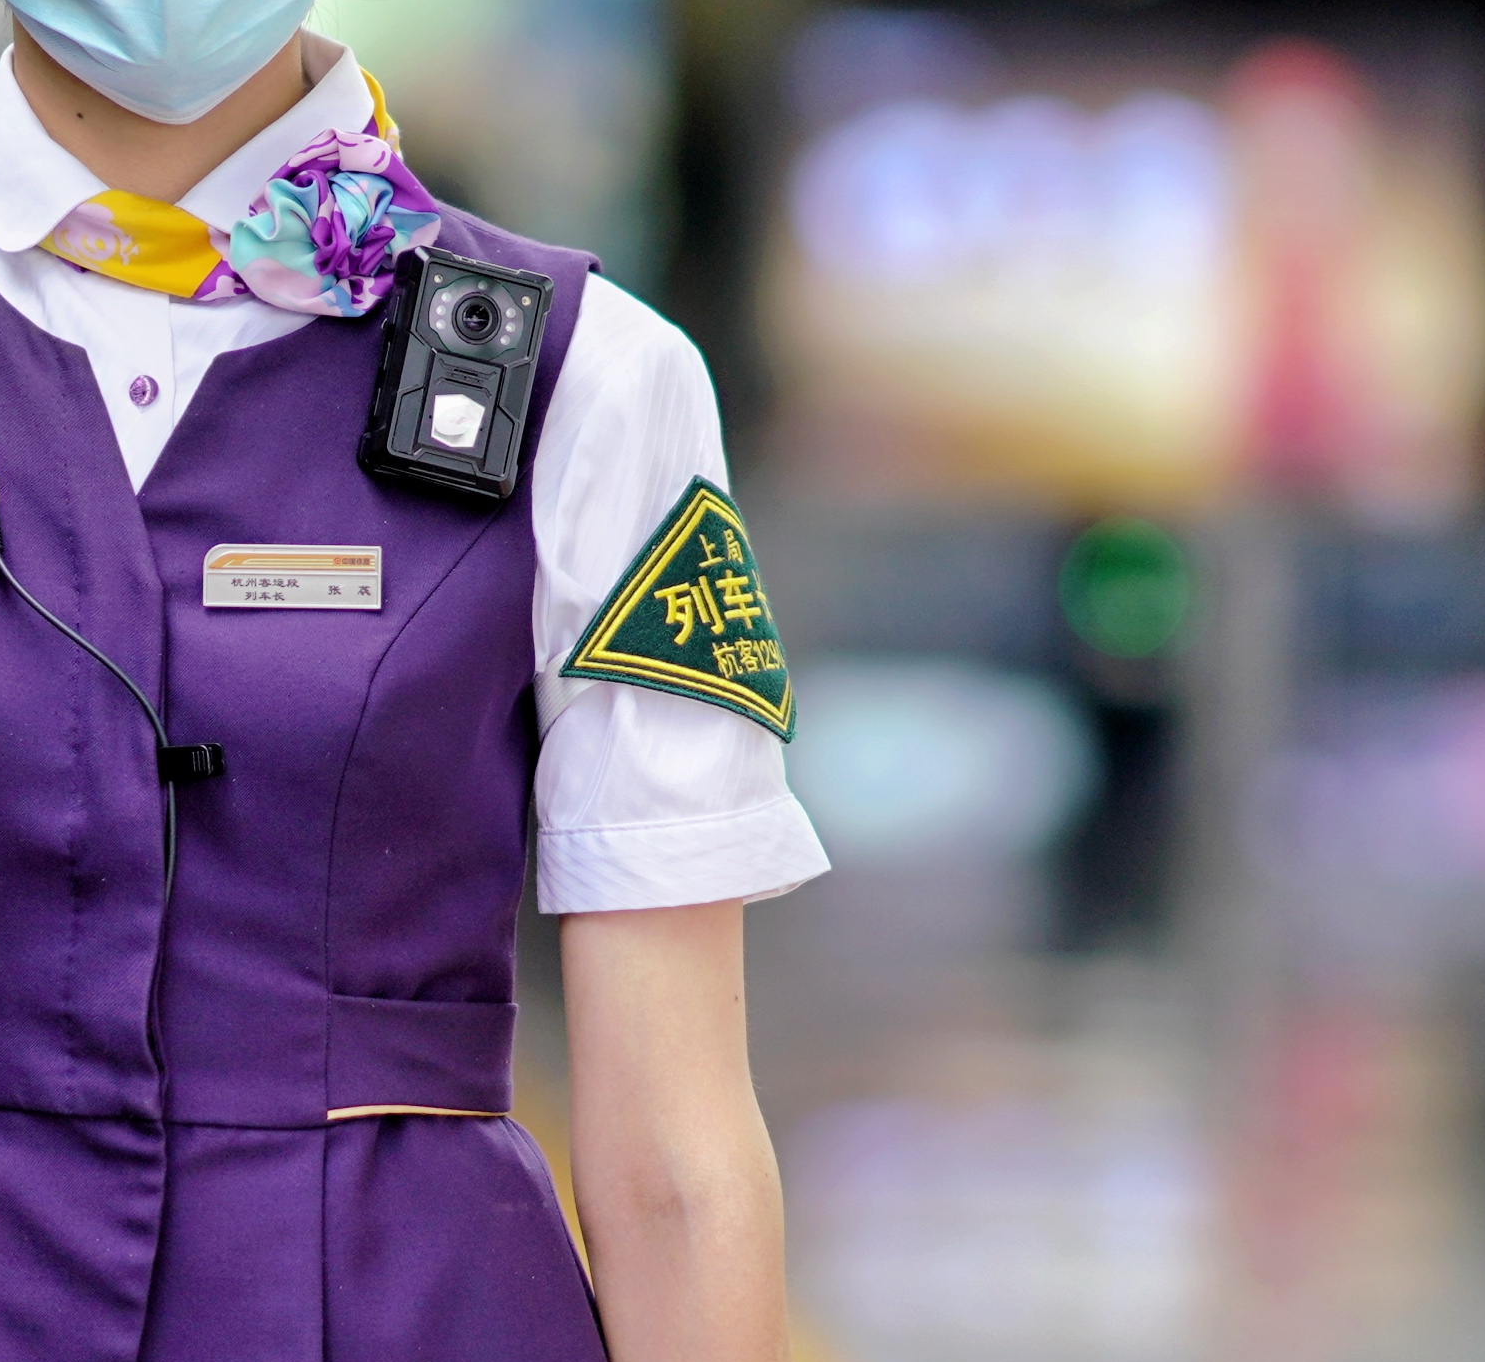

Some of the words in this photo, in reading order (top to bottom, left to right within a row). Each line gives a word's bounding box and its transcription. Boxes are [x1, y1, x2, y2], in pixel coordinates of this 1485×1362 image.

[230, 577, 300, 588] 杭州客运段
[244, 591, 286, 601] 列车长
